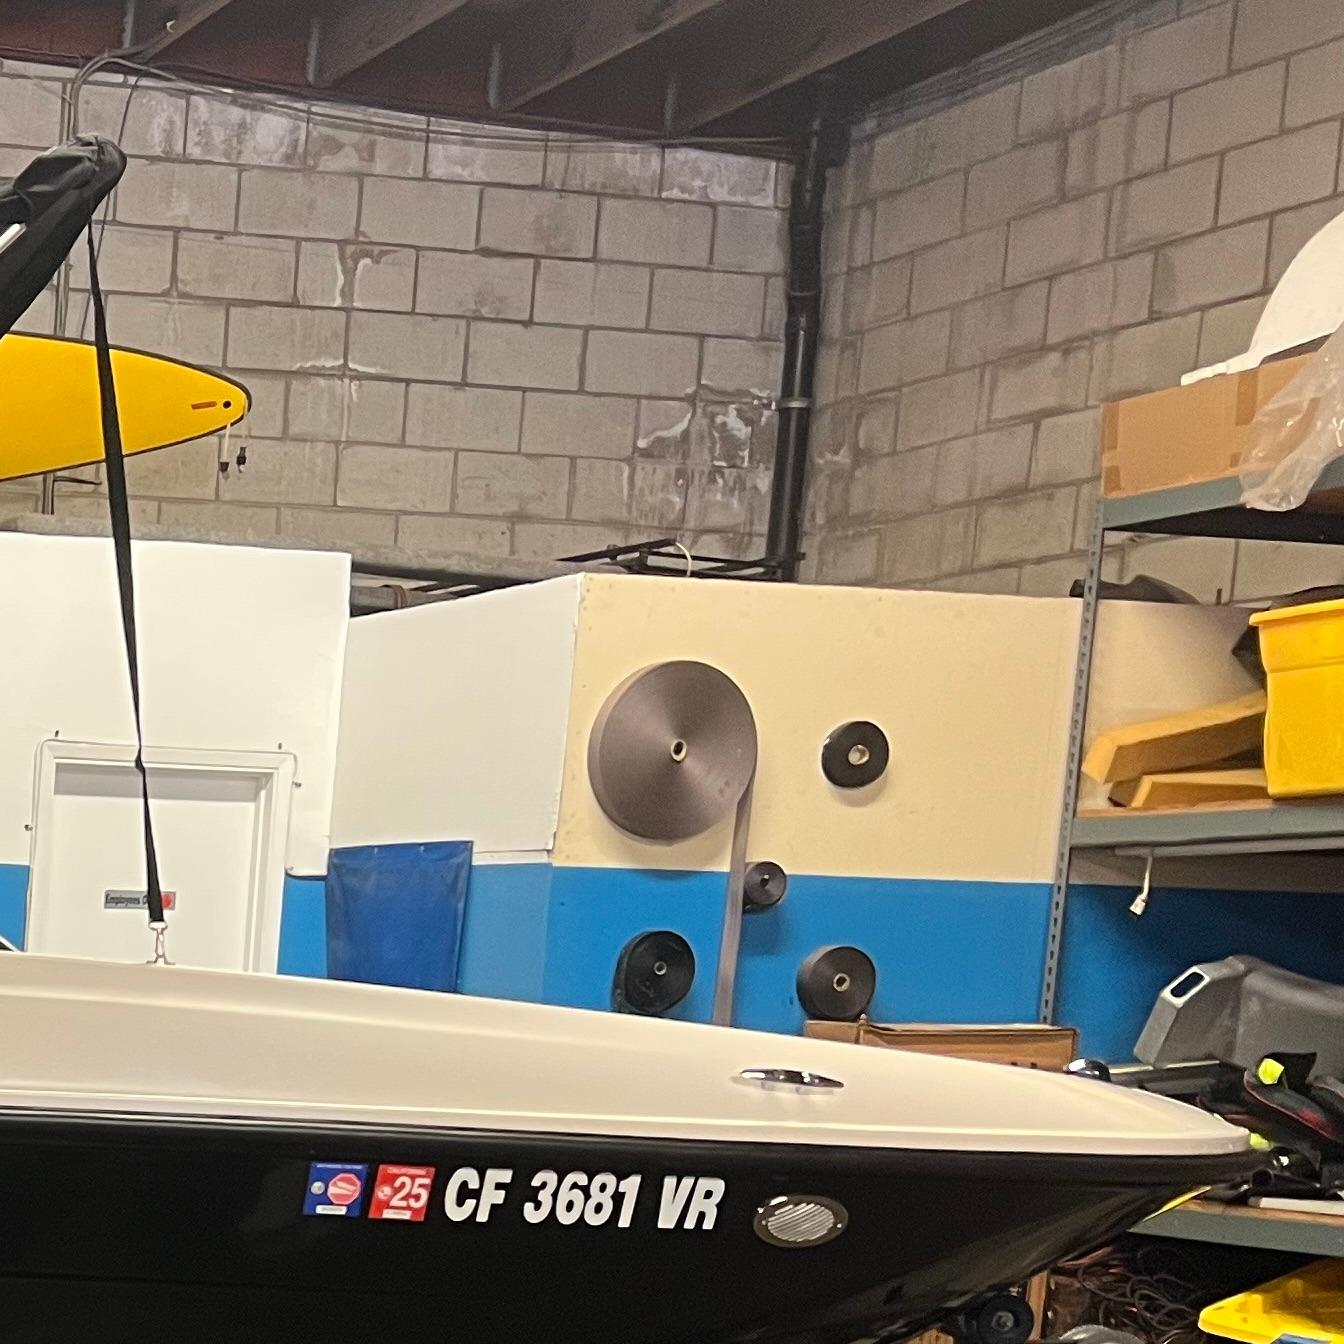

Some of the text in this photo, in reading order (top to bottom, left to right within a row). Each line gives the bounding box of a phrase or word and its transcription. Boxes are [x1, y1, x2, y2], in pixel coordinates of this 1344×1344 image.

[389, 1175, 431, 1209] 25
[444, 1167, 725, 1230] CF 3681 VR
